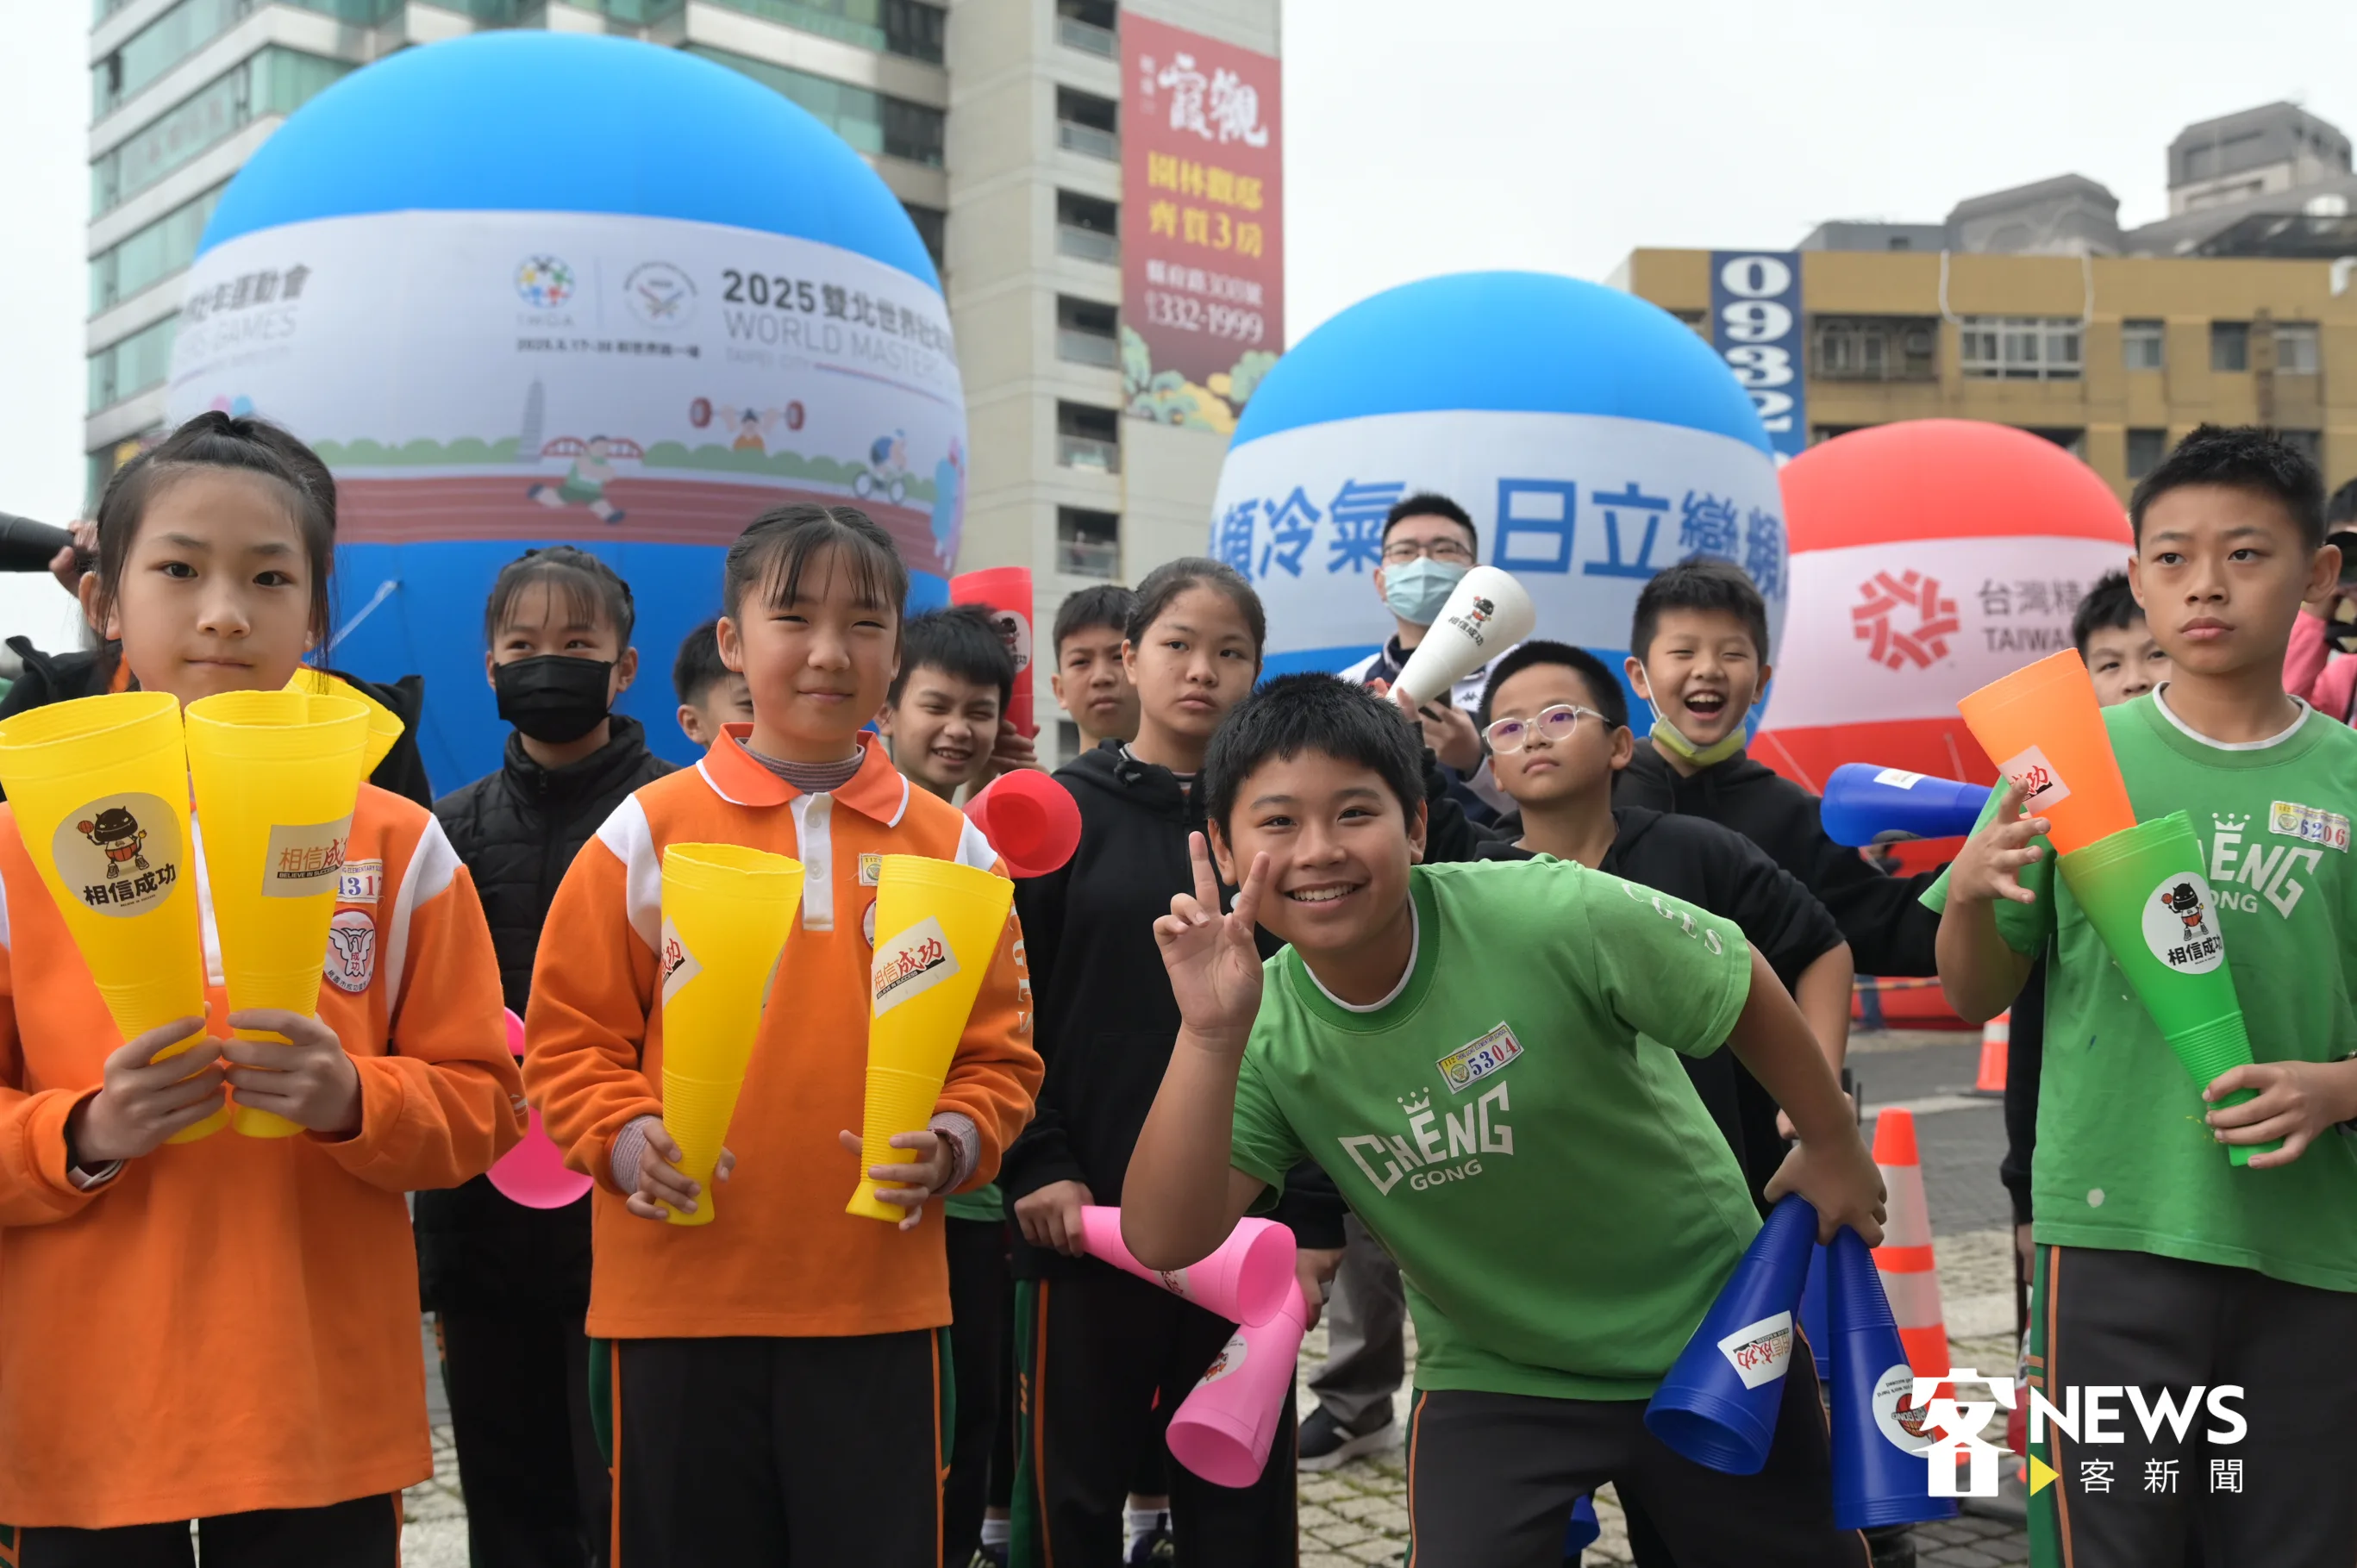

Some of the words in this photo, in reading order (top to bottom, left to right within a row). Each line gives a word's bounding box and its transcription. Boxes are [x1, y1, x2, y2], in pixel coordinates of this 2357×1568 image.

[722, 309, 843, 356] WORLD
[1721, 256, 1794, 464] 0932
[1976, 578, 2095, 615] 台灣精
[1448, 615, 1484, 647] 相信成功
[1982, 628, 2073, 652] TAIWA
[2300, 818, 2346, 846] 6206
[83, 863, 177, 906] 相信成功
[2200, 832, 2324, 920] ENG
[1622, 883, 1722, 955] CGES
[350, 952, 360, 971] 成功
[874, 937, 942, 992] 相信成功
[1444, 1057, 1456, 1067] 112
[1456, 1052, 1466, 1061] CHENG
[1475, 1036, 1495, 1051] ELEMENTARY
[1494, 1028, 1508, 1040] SCHOOL
[1467, 1037, 1518, 1076] 5304
[1338, 1080, 1514, 1196] CHENG
[1410, 1159, 1483, 1191] GONG
